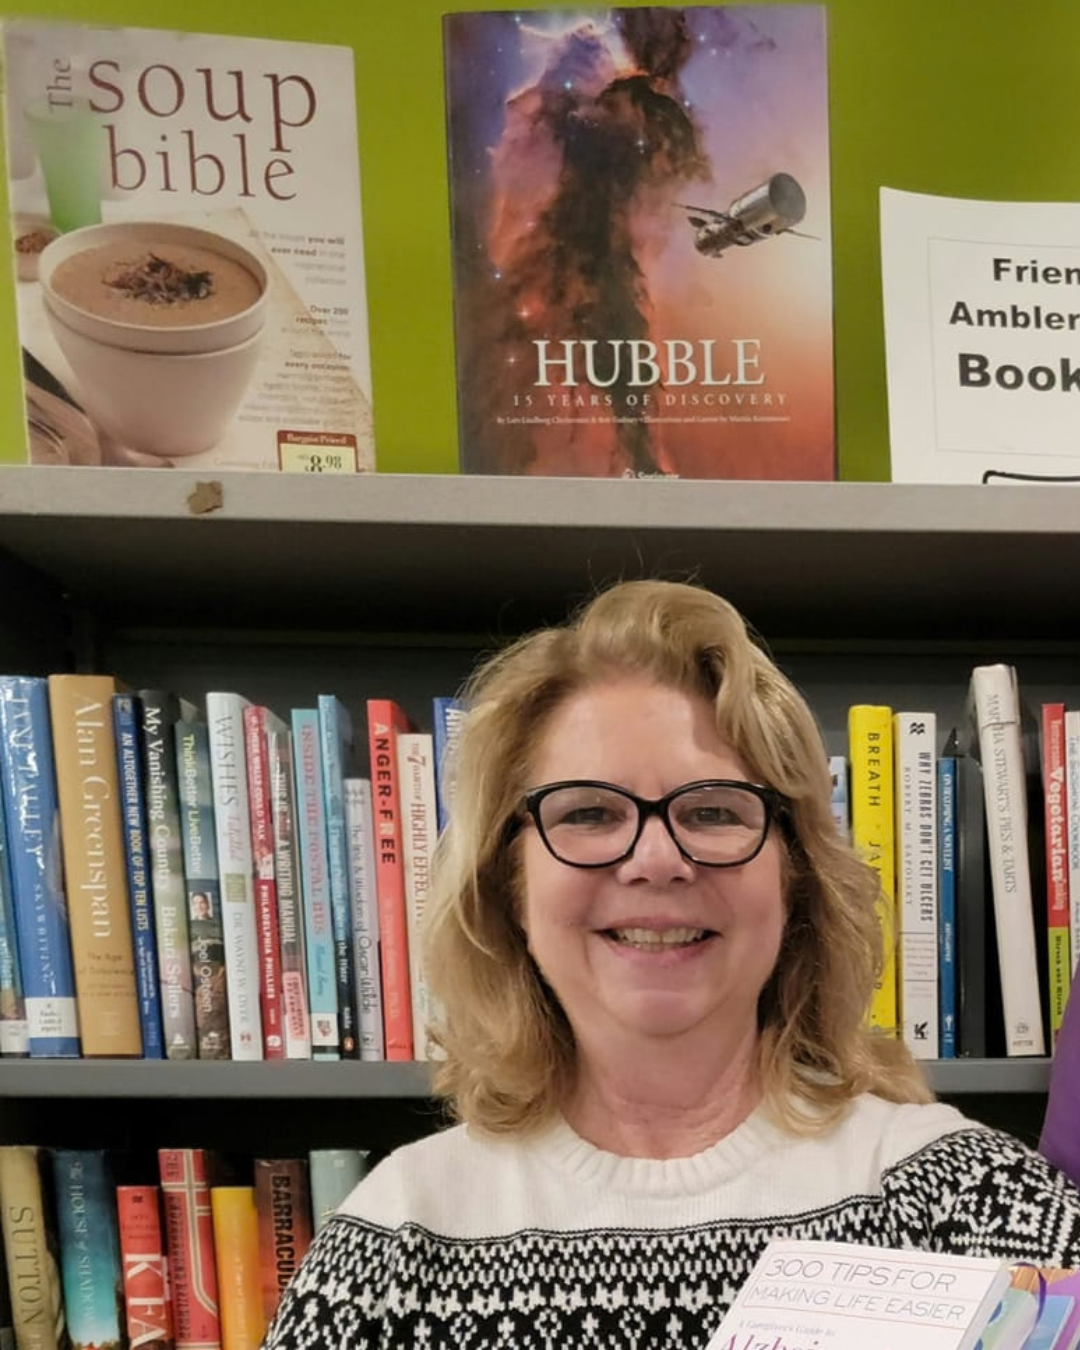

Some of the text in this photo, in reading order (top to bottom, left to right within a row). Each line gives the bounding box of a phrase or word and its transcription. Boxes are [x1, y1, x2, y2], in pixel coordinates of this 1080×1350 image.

[46, 58, 74, 114] The
[89, 60, 316, 152] soup
[102, 125, 297, 200] bible
[513, 393, 788, 407] 15 YEARS OF DISCOVERY
[533, 339, 765, 387] HUBBLE
[143, 707, 168, 820] My Vanishing
[215, 716, 239, 805] WISHES
[374, 723, 396, 864] ANGER-FREE
[407, 756, 428, 851] 7 HIGHLY
[867, 732, 882, 807] BREATH
[903, 767, 913, 814] ROBERT
[73, 693, 111, 938] Alan Greenspan
[123, 749, 147, 906] ALTOGETHER BOOK TOP TEN
[302, 724, 323, 894] INSIDE THE POSTAL
[919, 752, 935, 922] WHY ZEBRAS DON'T GET ULCERS
[260, 885, 276, 998] PHILADELPHIA PHILLIES
[278, 848, 296, 945] WRITING MANUAL
[358, 936, 378, 1014] Oscar Wilde
[10, 1205, 45, 1324] SUTTON
[752, 1286, 967, 1322] MAKING LIFE EASIER
[765, 1258, 958, 1292] 300 TIPS FOR
